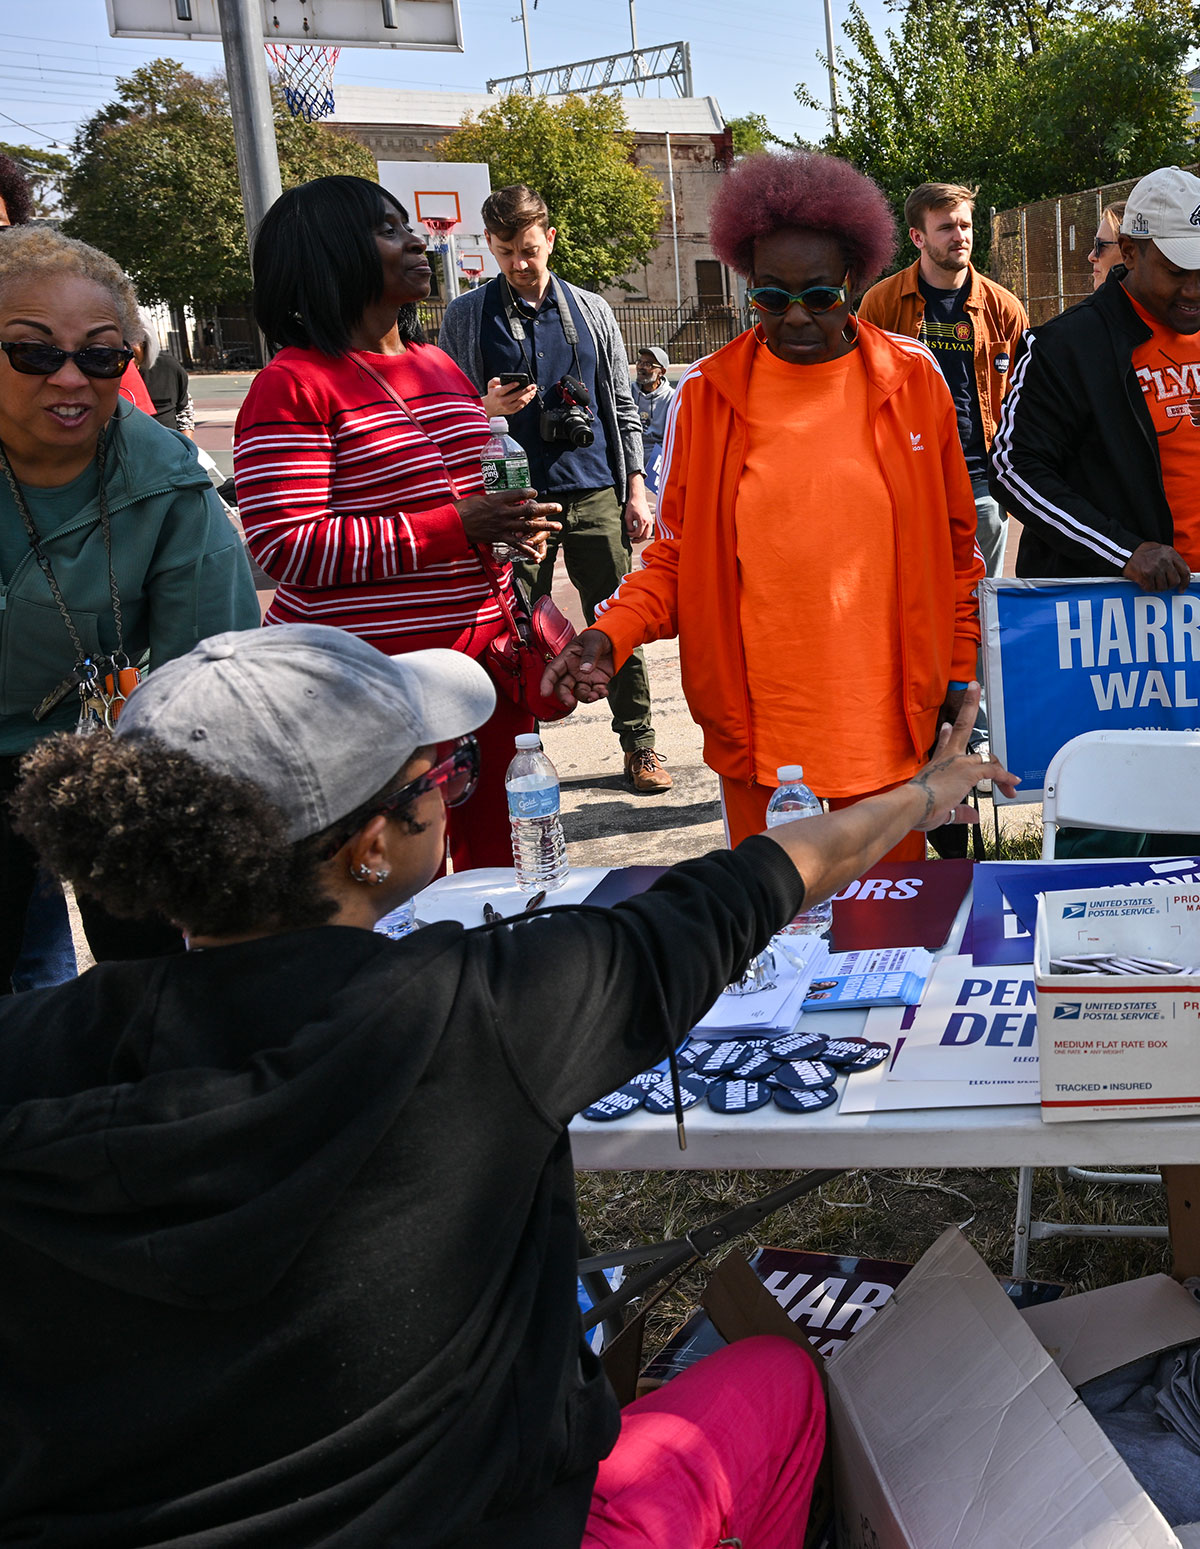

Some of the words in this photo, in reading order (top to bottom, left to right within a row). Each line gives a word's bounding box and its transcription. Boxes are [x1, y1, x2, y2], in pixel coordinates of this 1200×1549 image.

[921, 339, 974, 351] NSYLVAN
[1089, 899, 1122, 908] UNITED
[1123, 898, 1153, 906] STATES
[1087, 908, 1119, 917] POSTAL
[1120, 907, 1155, 916] SERVICE
[1084, 1002, 1122, 1010] UNITED
[1123, 1001, 1157, 1009] STATES
[1082, 1012, 1119, 1020] POSTAL
[1120, 1012, 1160, 1020] SERVICE
[1054, 1040, 1094, 1048] MEDIUM
[1096, 1040, 1118, 1048] FLAT
[1121, 1040, 1145, 1048] RATE
[1147, 1040, 1168, 1048] BOX
[1055, 1083, 1101, 1092] TRACKED
[1110, 1082, 1153, 1090] INSURED
[600, 1091, 640, 1110] RRIS
